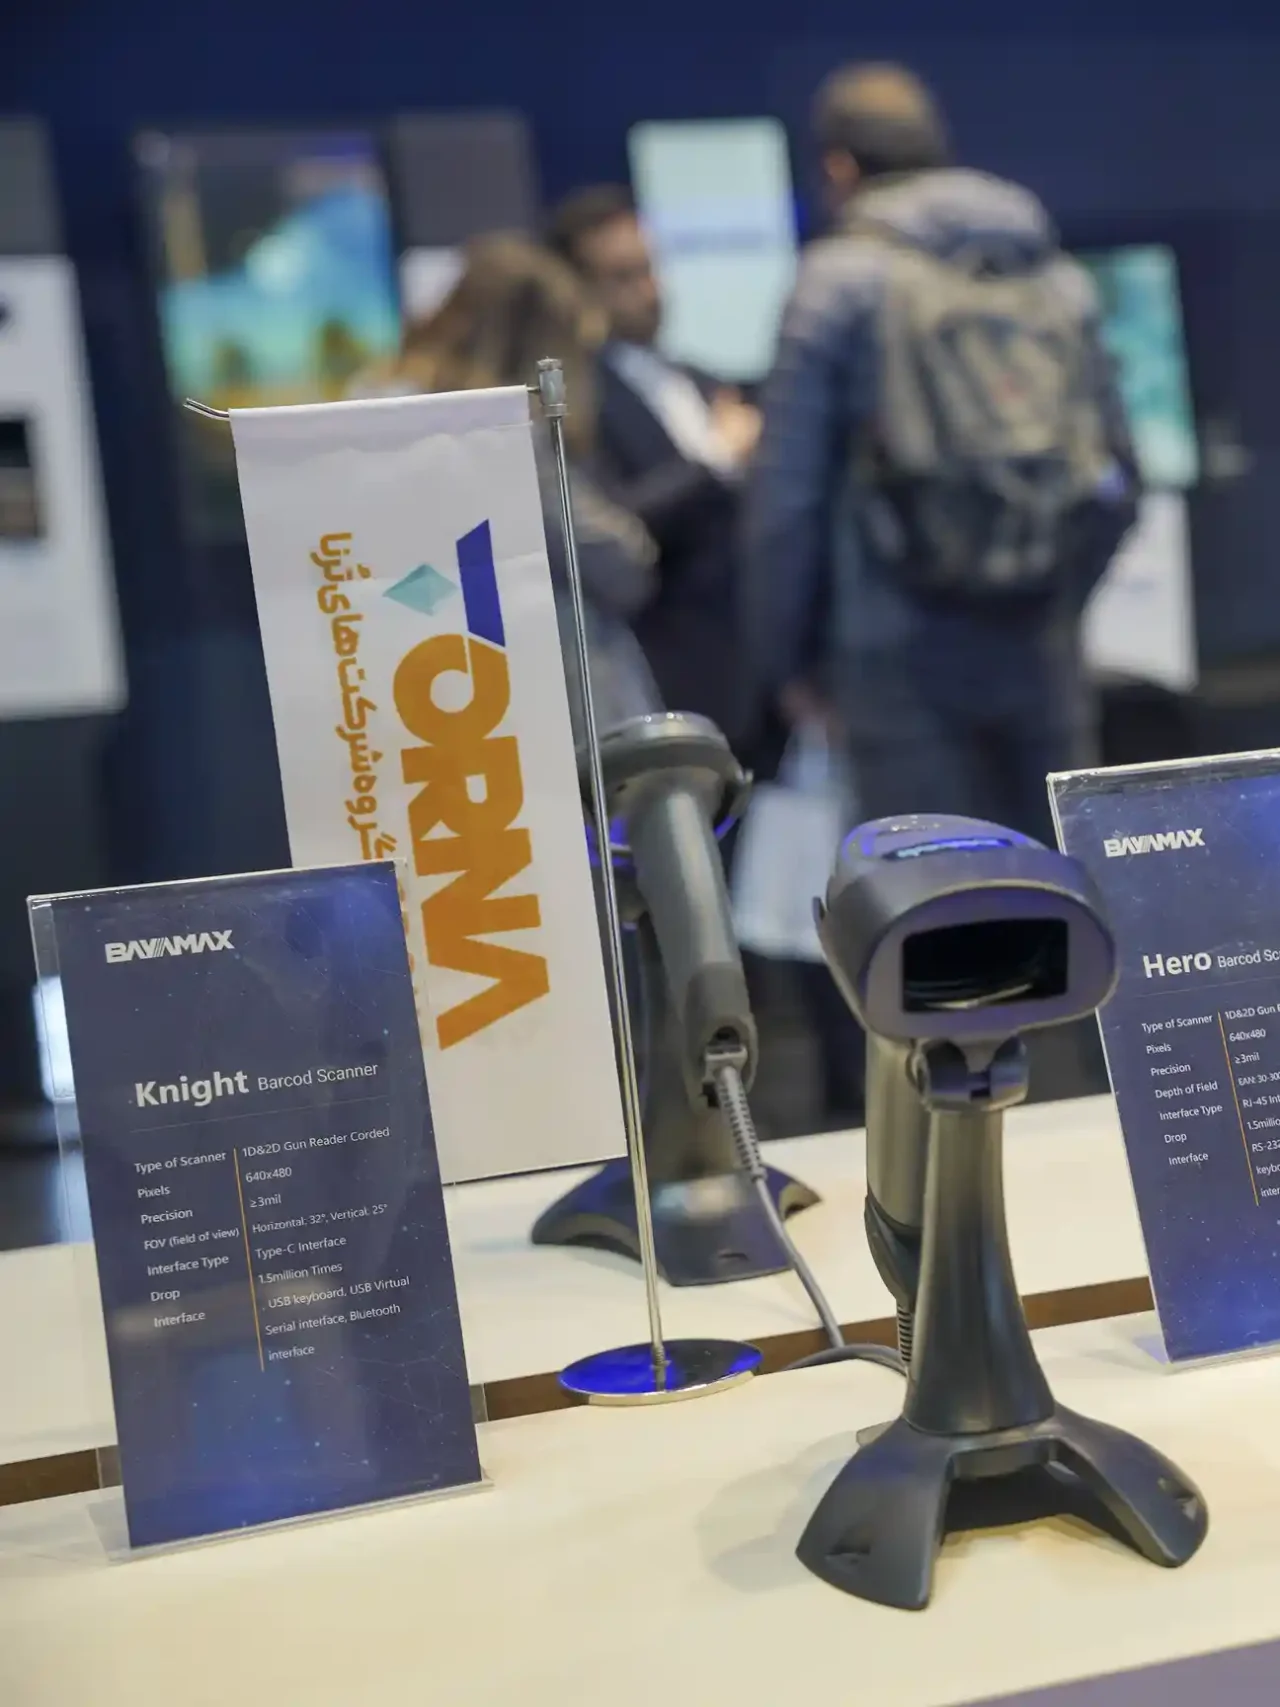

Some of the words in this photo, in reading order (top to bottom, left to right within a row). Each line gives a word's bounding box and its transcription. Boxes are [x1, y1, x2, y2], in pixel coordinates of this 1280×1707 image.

[1103, 828, 1205, 857] BAYAMAX
[105, 929, 235, 963] BAYAMAX
[1143, 952, 1212, 979] Hero
[1217, 952, 1261, 968] Barcod
[1224, 1007, 1255, 1020] 1D&2D
[1257, 1006, 1276, 1015] Gun
[1142, 1020, 1164, 1034] Type
[1165, 1019, 1175, 1029] of
[1177, 1014, 1212, 1027] Scanner
[1229, 1028, 1266, 1042] 640x480
[1146, 1043, 1172, 1054] Pixels
[1150, 1063, 1191, 1076] Precision
[134, 1070, 249, 1107] Knight
[257, 1070, 312, 1092] Barcod
[316, 1063, 379, 1083] Scanner
[1155, 1086, 1183, 1099] Depth
[1185, 1084, 1195, 1094] of
[1196, 1081, 1218, 1092] Field
[1242, 1096, 1268, 1108] RJ-45
[1160, 1106, 1199, 1121] Interface
[1200, 1103, 1223, 1116] Type
[242, 1143, 281, 1157] 1D&2D
[283, 1140, 307, 1151] Gun
[309, 1134, 348, 1148] Reader
[350, 1127, 390, 1142] Corded
[1164, 1132, 1187, 1144] Drop
[134, 1161, 163, 1175] Type
[164, 1157, 177, 1169] of
[180, 1152, 227, 1167] Scanner
[1169, 1152, 1209, 1166] Interface
[245, 1166, 292, 1183] 640x480
[137, 1185, 171, 1198] Pixels
[249, 1194, 282, 1208] ≥3mil
[140, 1209, 194, 1224] Precision
[309, 1213, 329, 1224] 32°,
[372, 1204, 388, 1215] 25°
[144, 1239, 167, 1250] FOV
[169, 1233, 196, 1248] (field
[198, 1231, 210, 1243] of
[211, 1227, 240, 1240] view)
[255, 1243, 295, 1260] Type-C
[298, 1236, 347, 1252] Interface
[147, 1259, 199, 1276] Interface
[200, 1254, 230, 1270] Type
[258, 1268, 309, 1284] 1.5million
[311, 1263, 343, 1276] Times
[150, 1289, 181, 1302] Drop
[268, 1296, 291, 1309] USB
[293, 1287, 347, 1306] keyboard,
[350, 1282, 372, 1295] USB
[374, 1276, 410, 1290] Virtual
[154, 1311, 206, 1328] Interface
[265, 1321, 296, 1336] Serial
[299, 1313, 347, 1329] interface,
[350, 1303, 401, 1321] Bluetooth
[268, 1344, 315, 1361] interface
